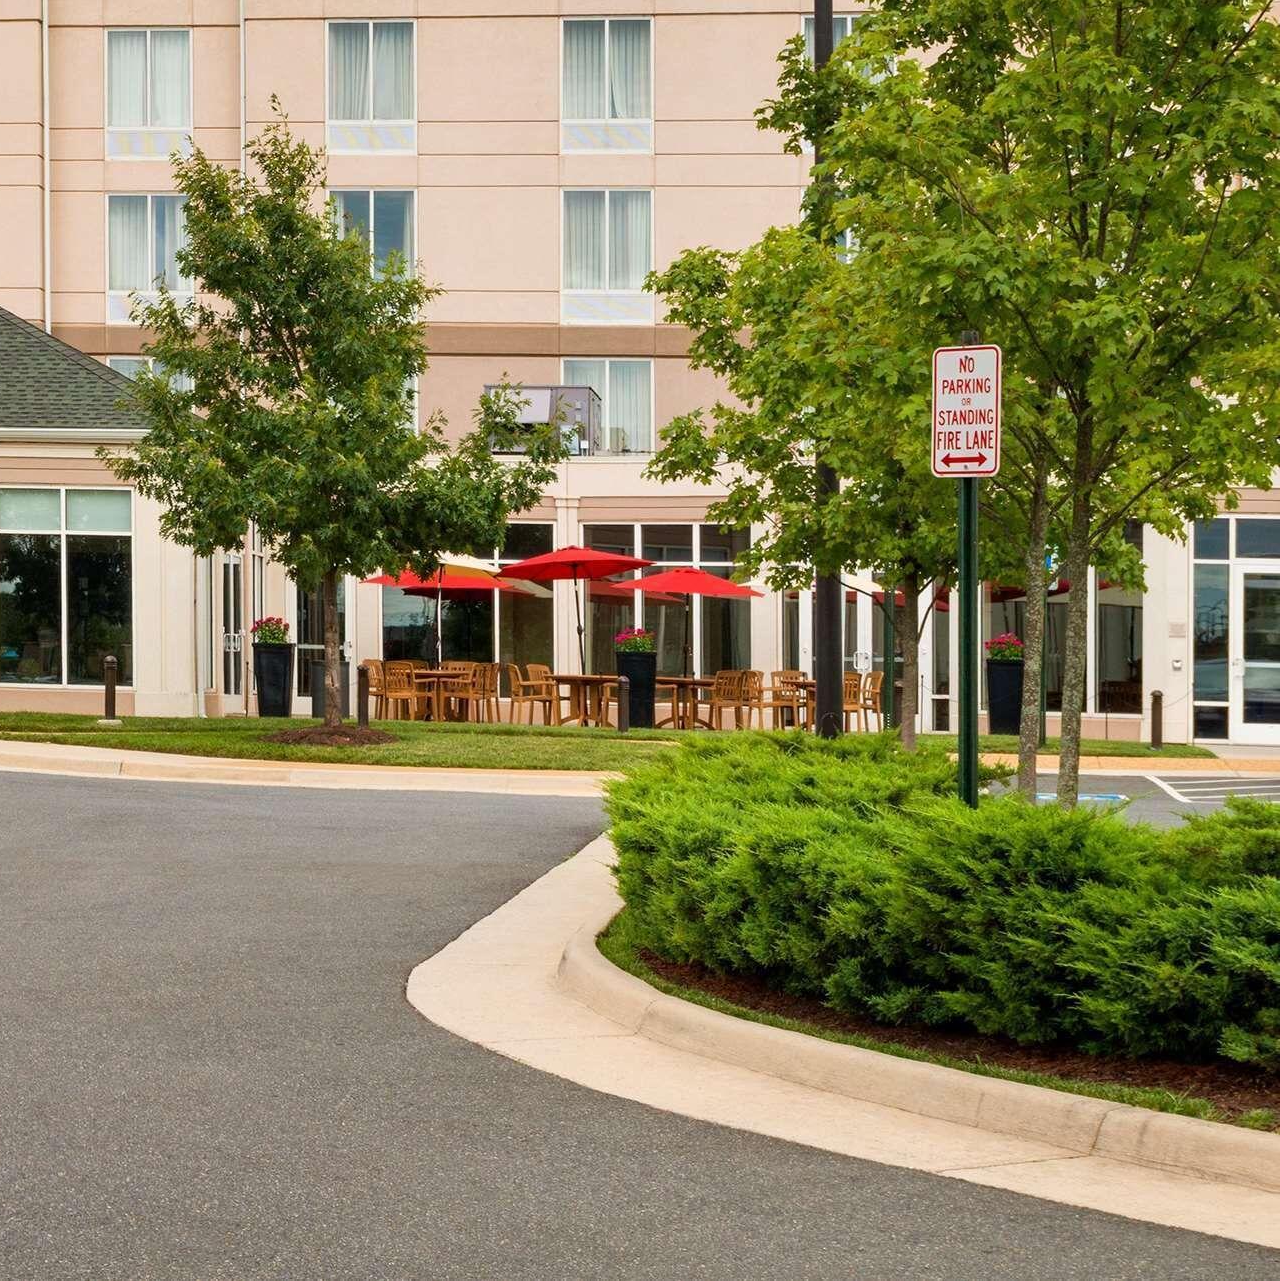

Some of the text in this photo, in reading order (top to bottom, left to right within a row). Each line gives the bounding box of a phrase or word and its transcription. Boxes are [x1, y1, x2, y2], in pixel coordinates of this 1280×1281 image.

[959, 357, 975, 373] NO
[942, 377, 991, 395] PARKING
[961, 397, 971, 406] OR
[938, 409, 994, 426] STANDING
[937, 430, 994, 450] FIRE LANE
